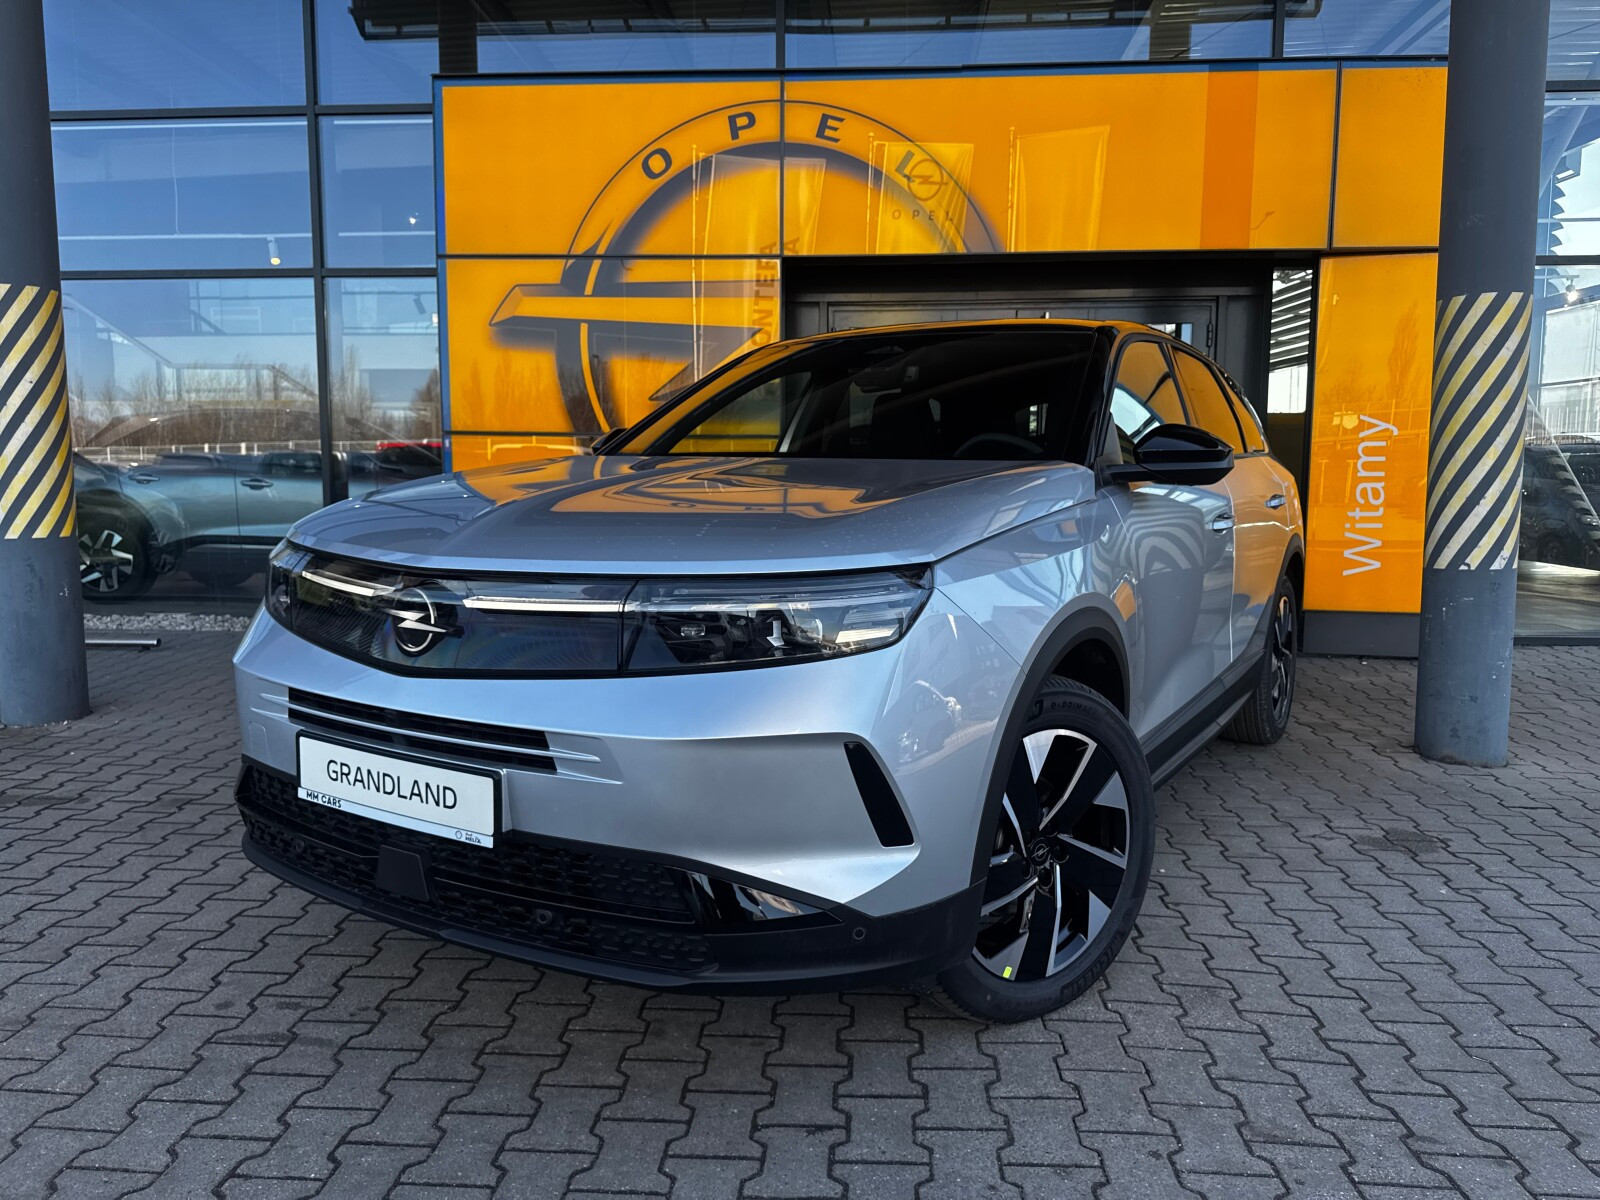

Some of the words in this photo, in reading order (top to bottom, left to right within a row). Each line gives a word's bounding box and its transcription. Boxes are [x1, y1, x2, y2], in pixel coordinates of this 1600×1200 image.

[641, 111, 916, 183] OPEL
[892, 209, 956, 221] OPEL
[1342, 414, 1399, 576] Witamy
[306, 790, 319, 802] MM
[321, 796, 342, 809] CARS
[326, 759, 458, 810] GRANDLAND
